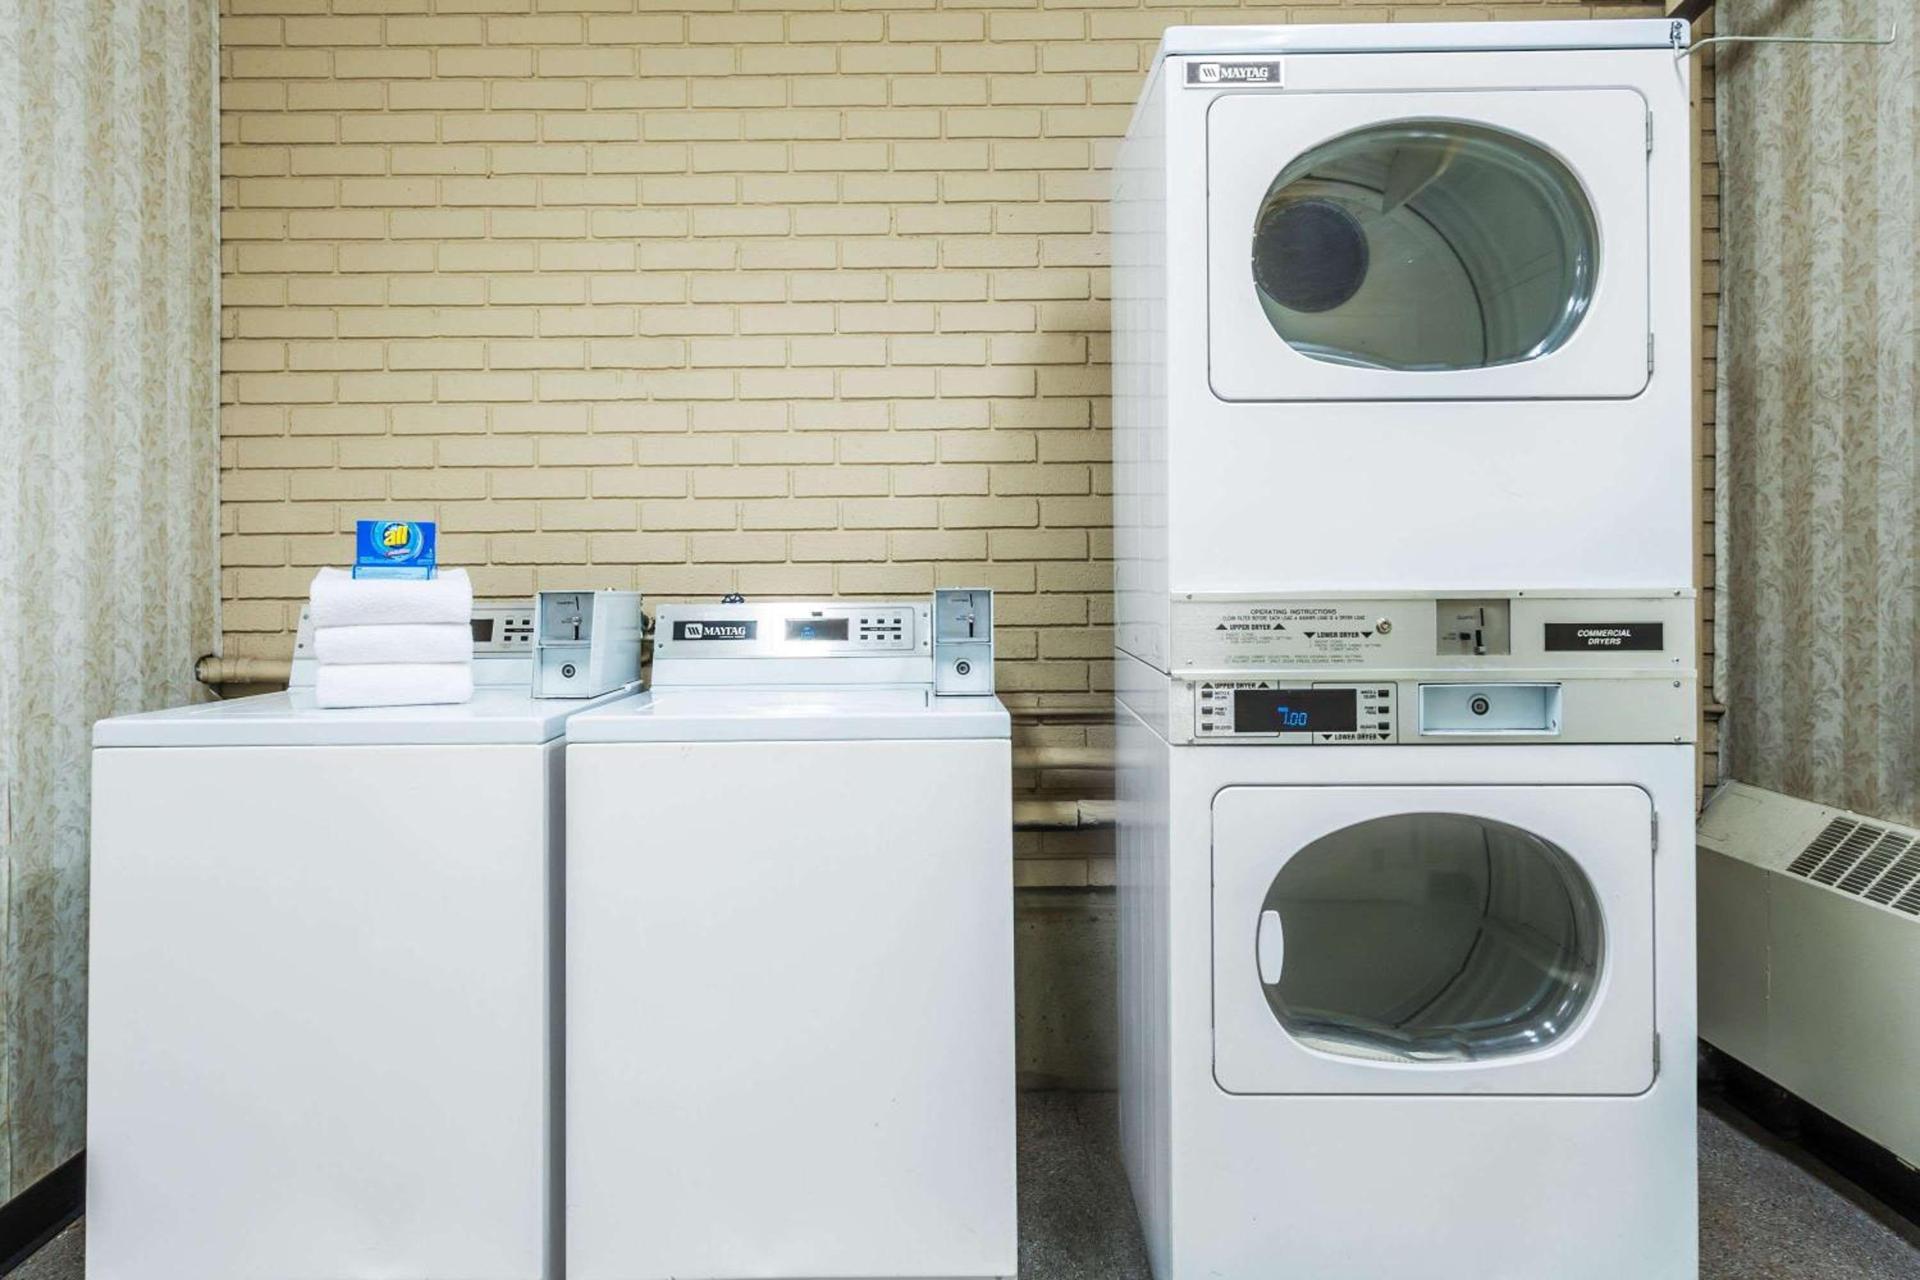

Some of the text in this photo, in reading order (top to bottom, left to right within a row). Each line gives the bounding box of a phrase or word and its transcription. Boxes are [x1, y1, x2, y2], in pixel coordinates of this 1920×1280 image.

[1220, 66, 1269, 79] MAYTAG
[383, 525, 409, 546] all
[703, 626, 746, 636] MAYTAG
[1229, 623, 1271, 631] UPPER DRYER
[1316, 631, 1360, 639] LOWER DRYER
[1577, 629, 1632, 637] COMMERCIAL
[1587, 637, 1622, 646] DRYERS
[1214, 682, 1235, 690] UPPER
[1334, 733, 1356, 741] LOWER
